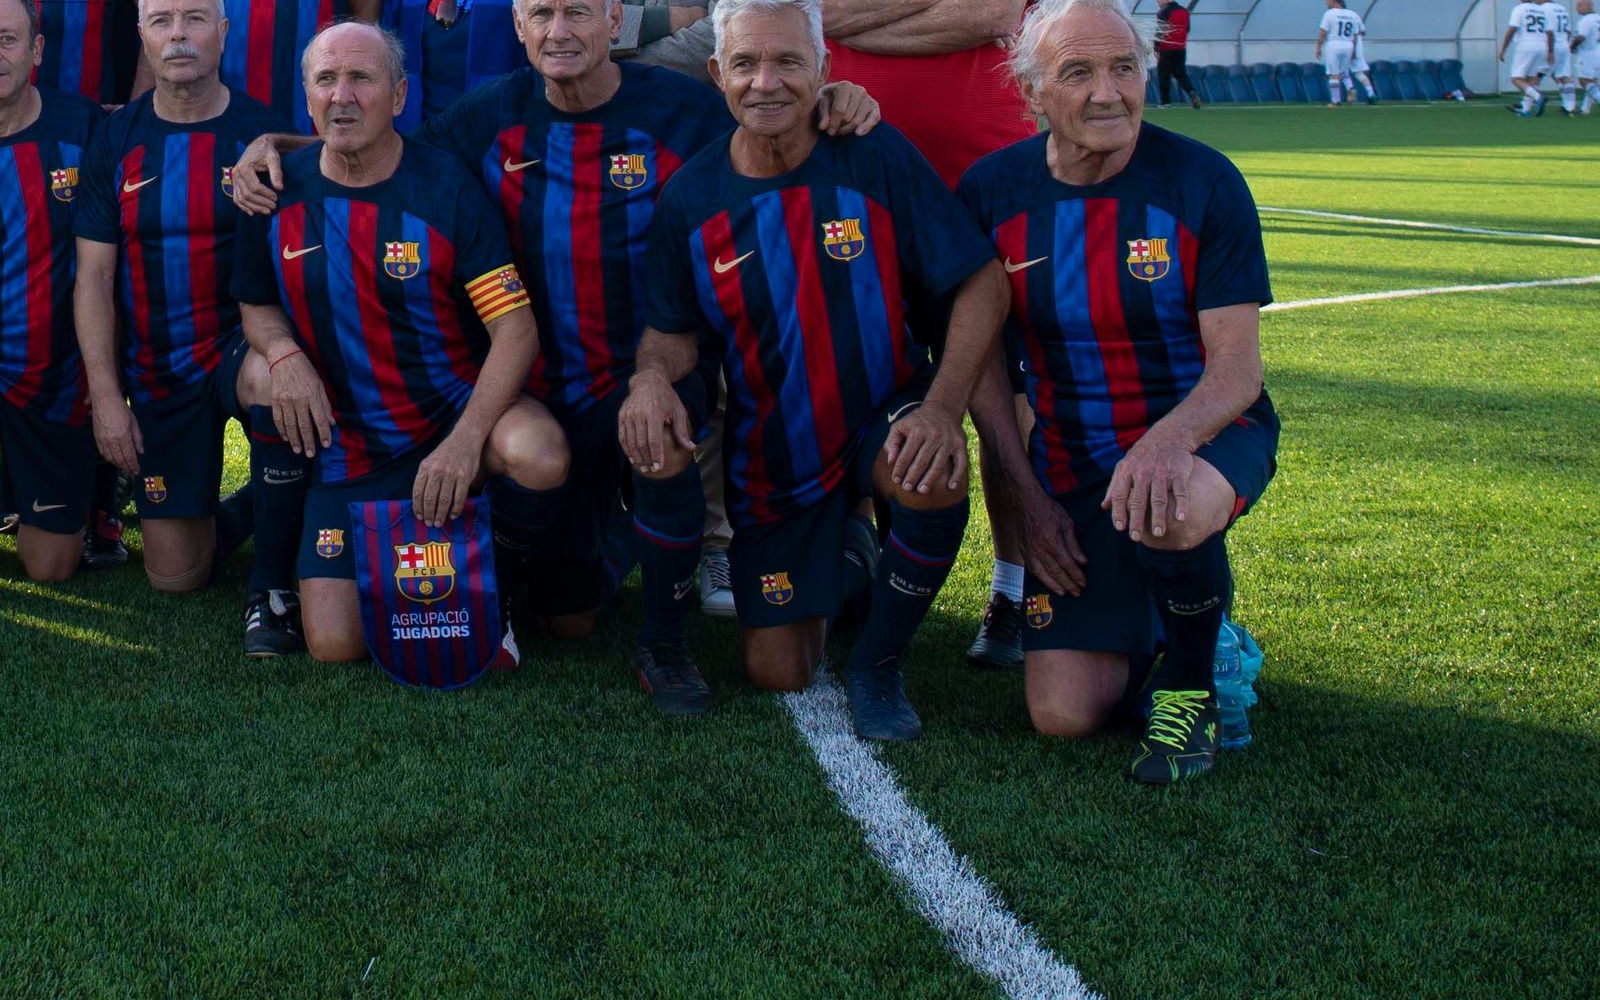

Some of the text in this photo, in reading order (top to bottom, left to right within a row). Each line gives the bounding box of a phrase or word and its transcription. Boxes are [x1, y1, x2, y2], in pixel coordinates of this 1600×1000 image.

[1337, 20, 1354, 37] 18
[1525, 14, 1546, 34] 25
[412, 567, 437, 577] FCB
[391, 608, 470, 626] AGRUPACIÓ
[392, 625, 471, 640] JUGADORS
